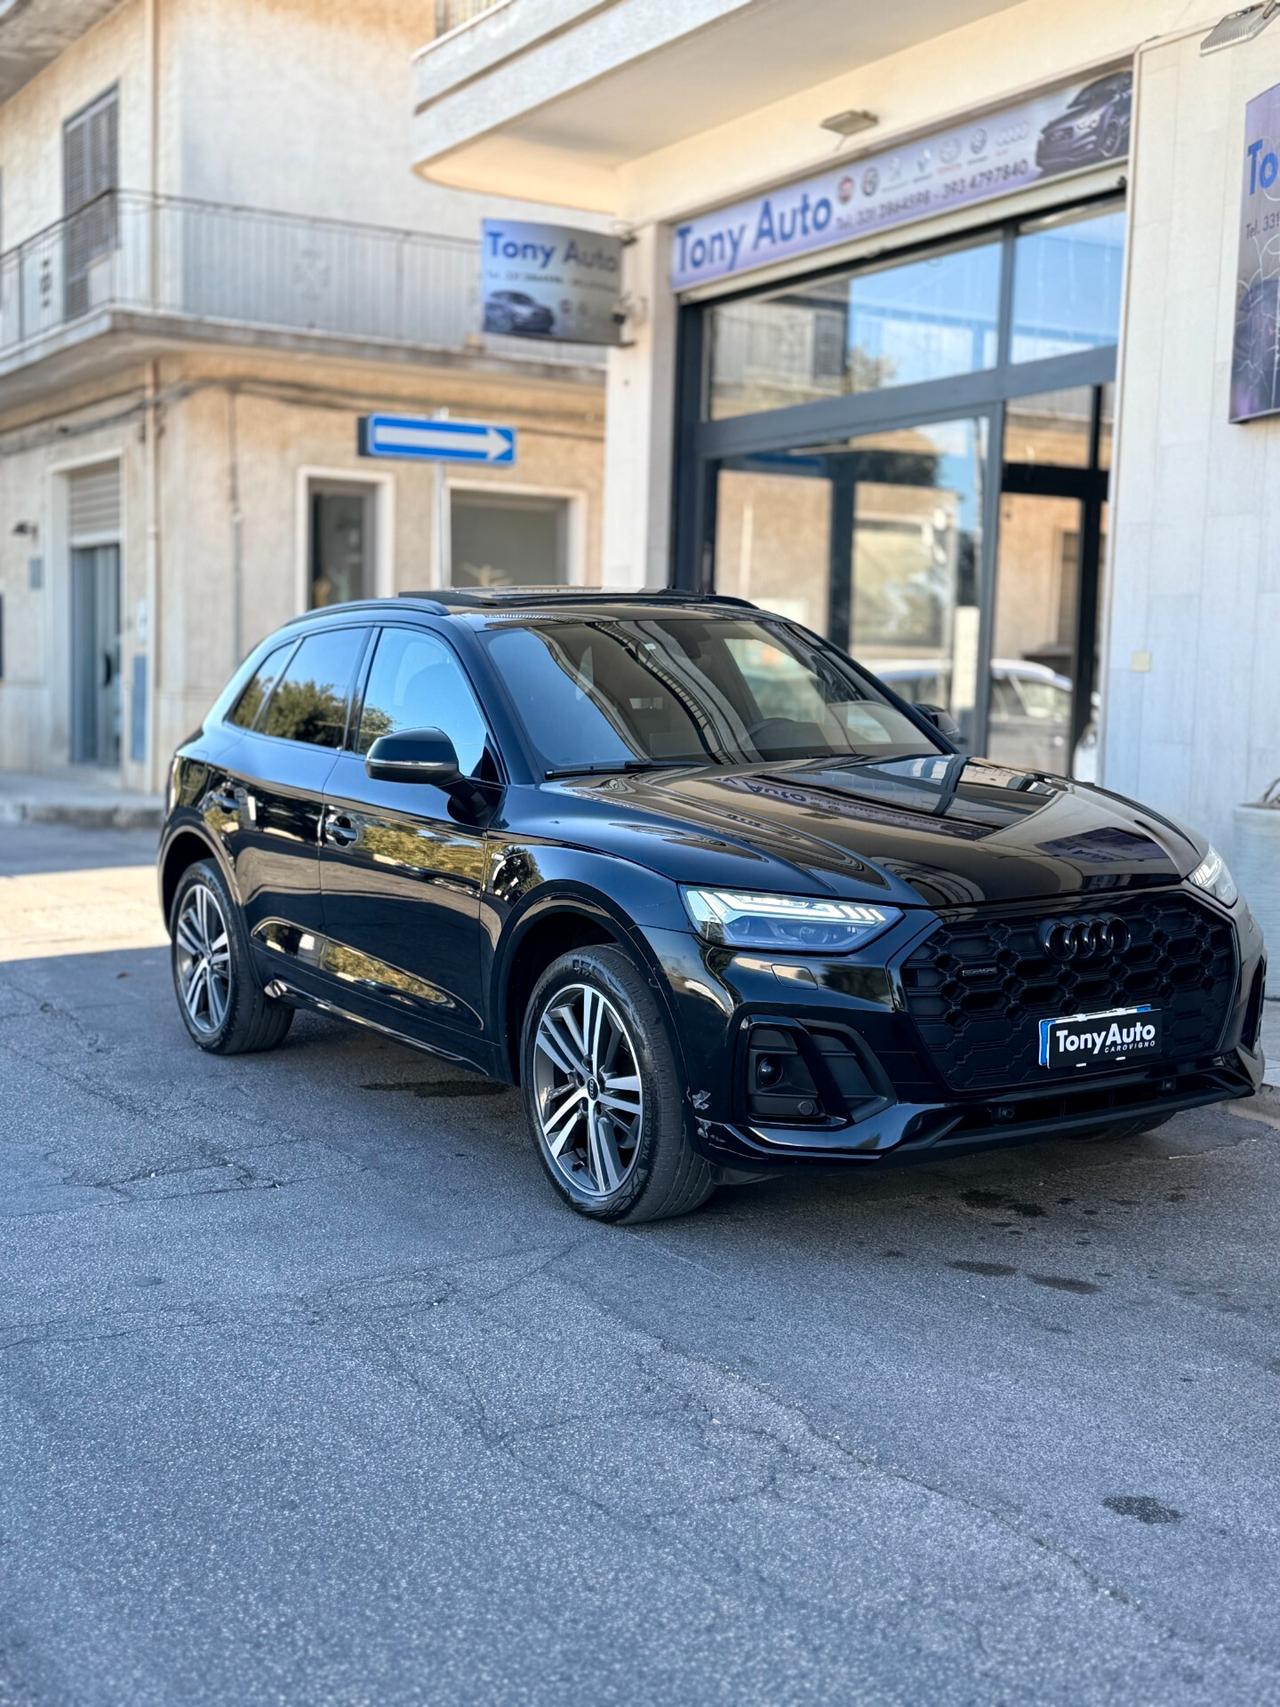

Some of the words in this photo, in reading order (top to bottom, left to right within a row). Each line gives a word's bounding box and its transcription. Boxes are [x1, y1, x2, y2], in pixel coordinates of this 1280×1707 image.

[487, 231, 555, 269] Tony
[563, 239, 617, 272] Auto
[676, 225, 746, 272] Tony
[752, 193, 833, 250] Auto
[1104, 1040, 1156, 1053] CAROVIGNO
